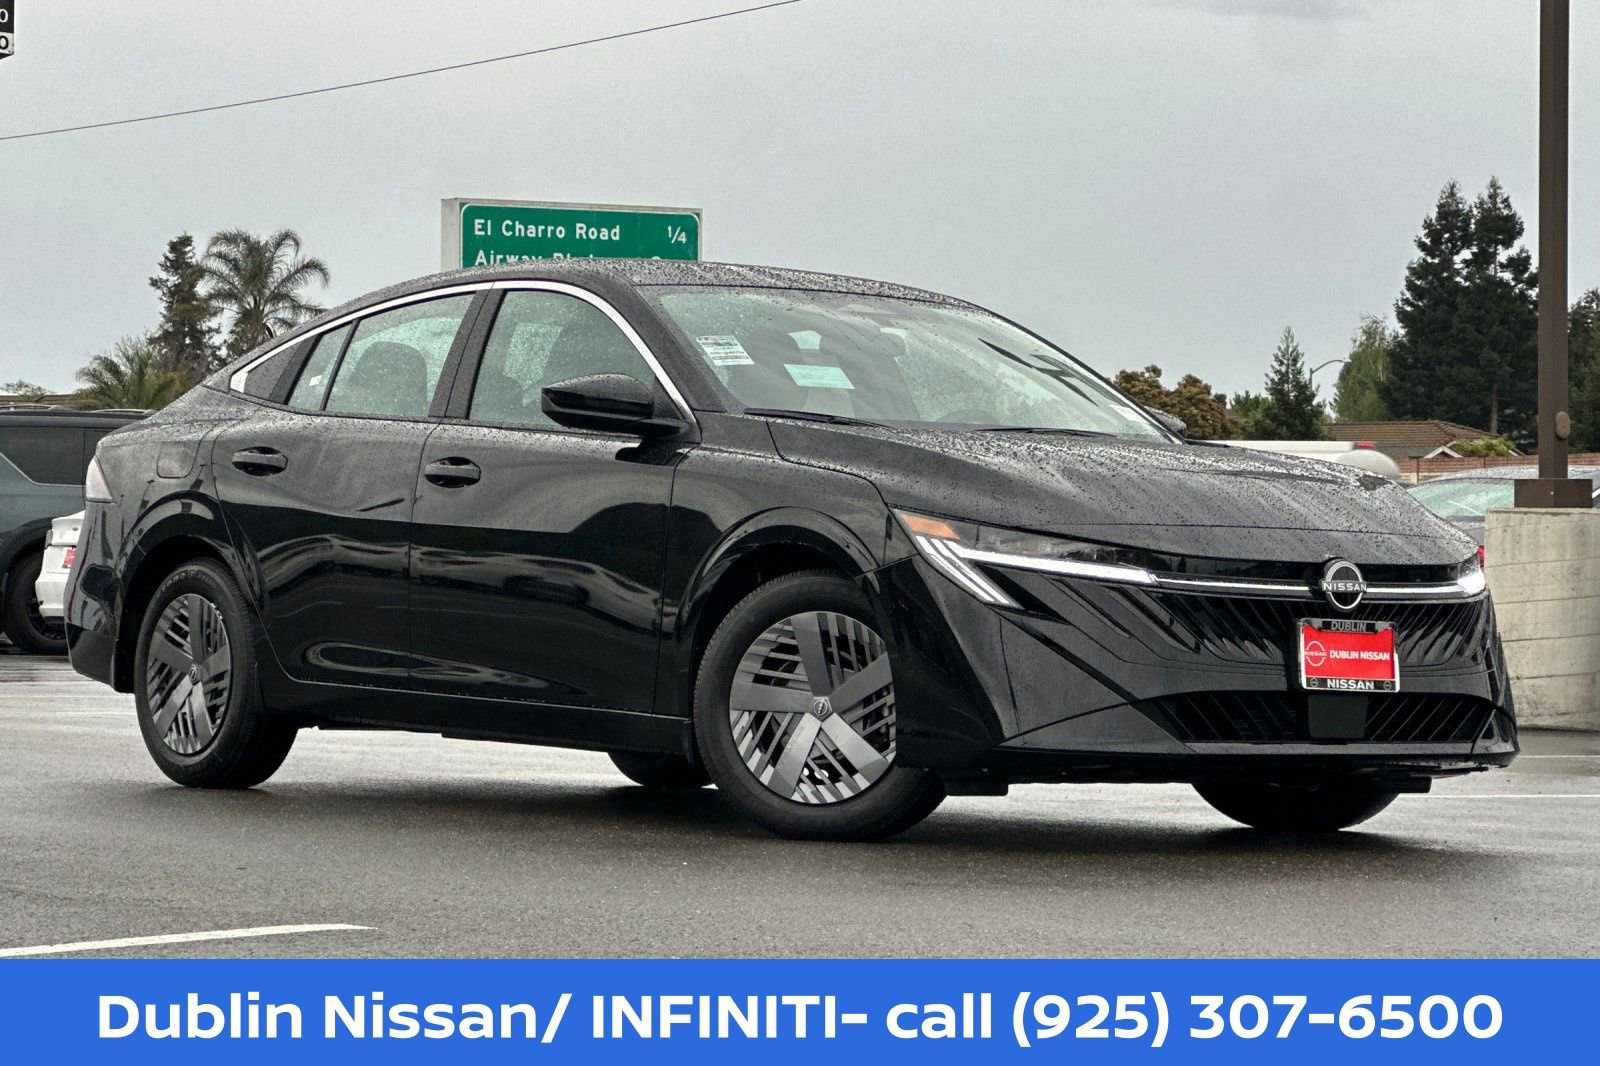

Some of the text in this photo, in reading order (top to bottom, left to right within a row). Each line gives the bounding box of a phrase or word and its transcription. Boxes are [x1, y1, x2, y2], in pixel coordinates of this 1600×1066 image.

[474, 218, 620, 241] El Charro Road
[1322, 582, 1367, 591] NISSAN
[1331, 621, 1367, 632] DUBLIN
[1329, 650, 1390, 660] DUBLIN NISSAN
[1327, 679, 1374, 690] NISSAN
